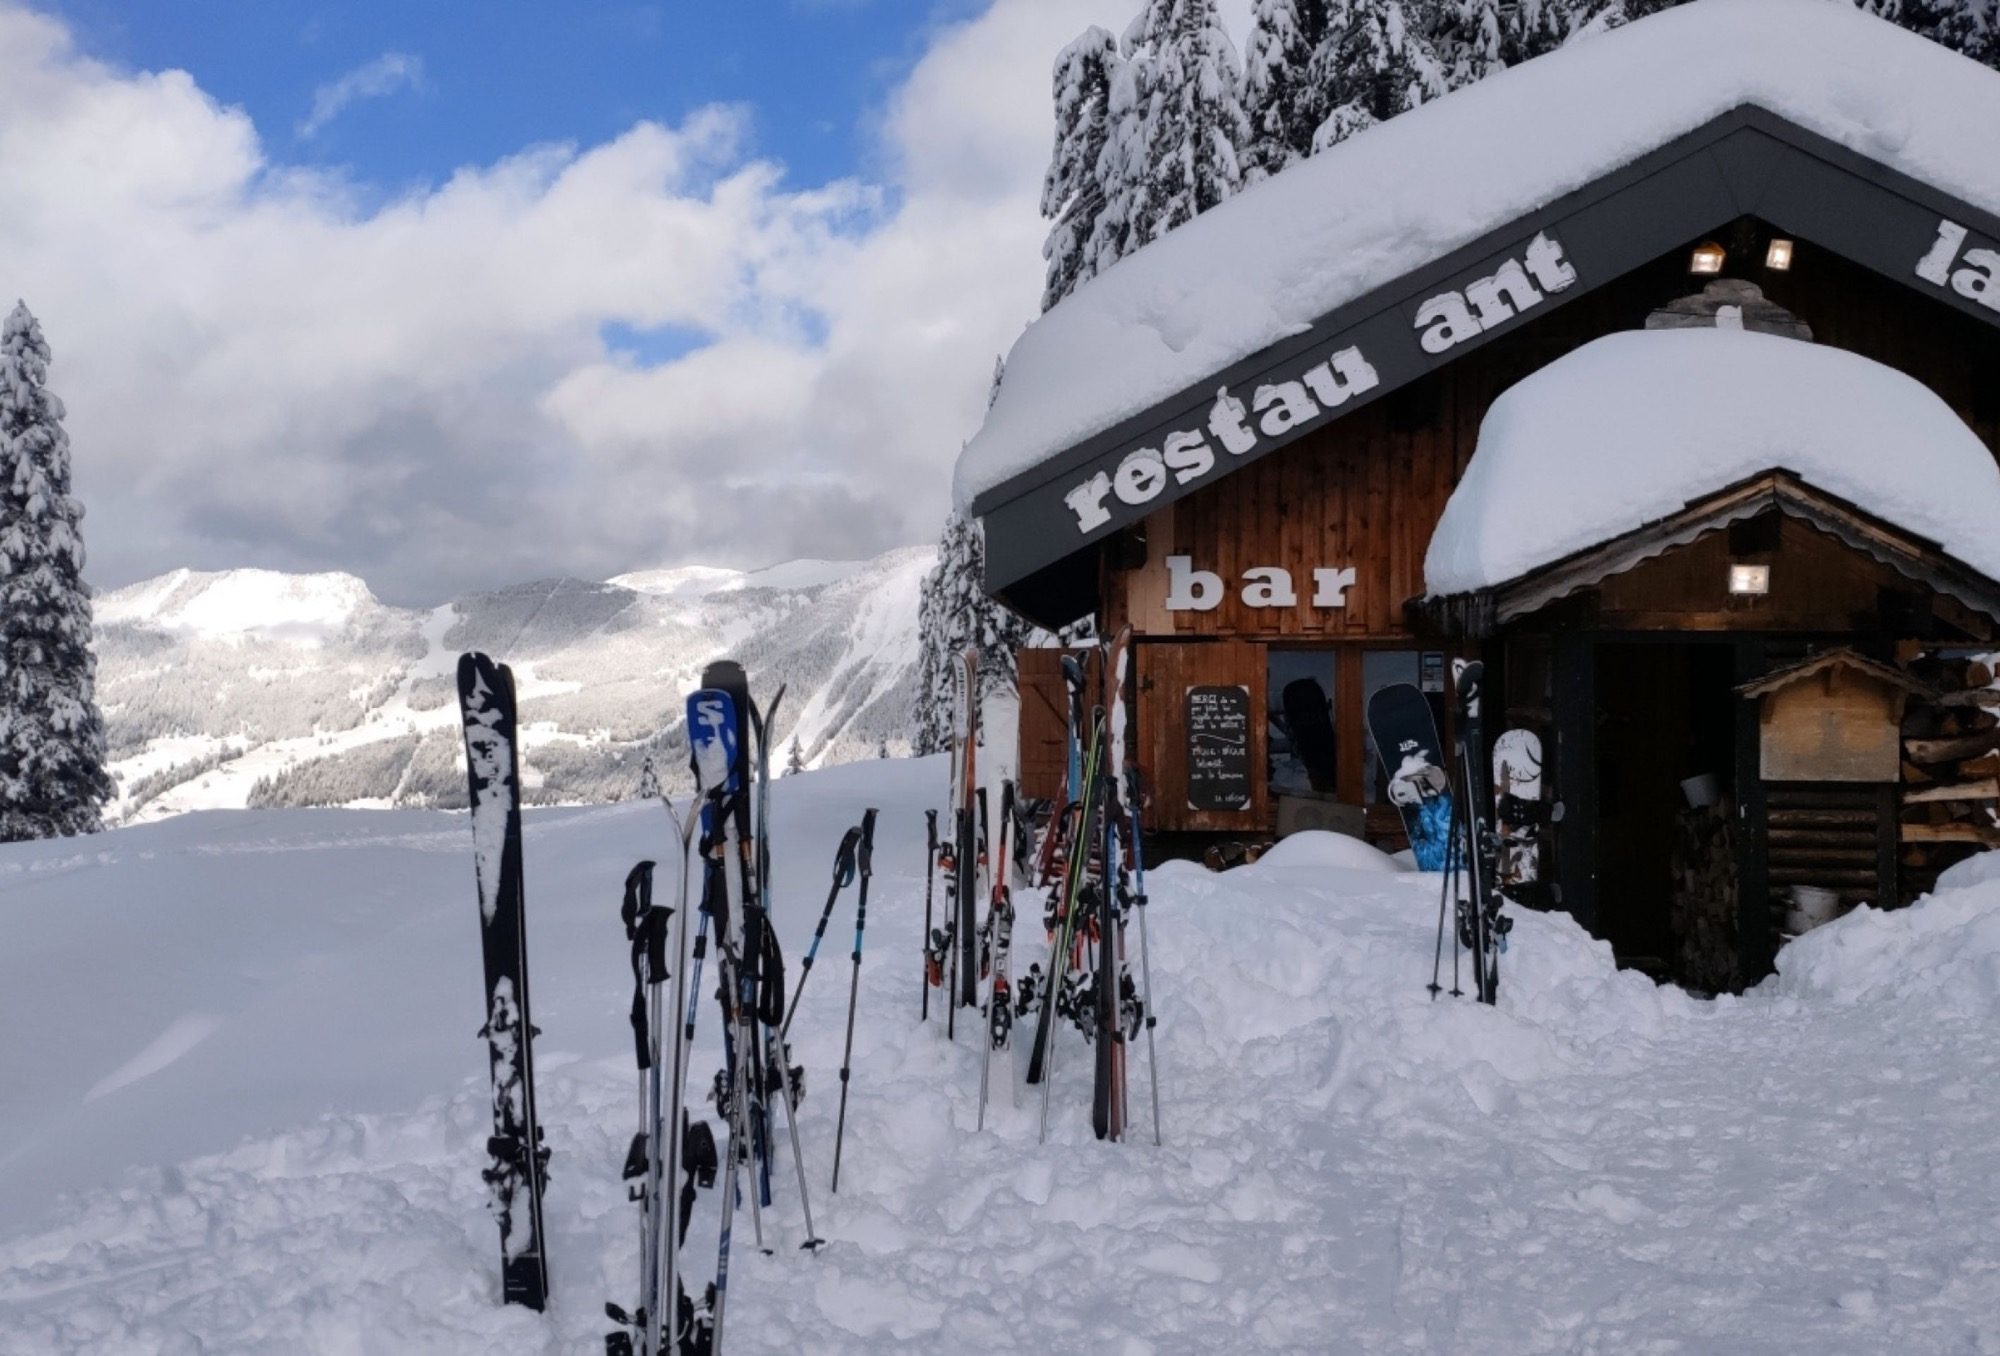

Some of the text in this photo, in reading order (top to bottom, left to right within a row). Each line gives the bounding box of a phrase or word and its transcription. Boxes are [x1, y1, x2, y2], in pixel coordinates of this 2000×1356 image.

[1915, 219, 2000, 313] la
[1064, 230, 1577, 533] restau ant
[1165, 555, 1356, 611] bar
